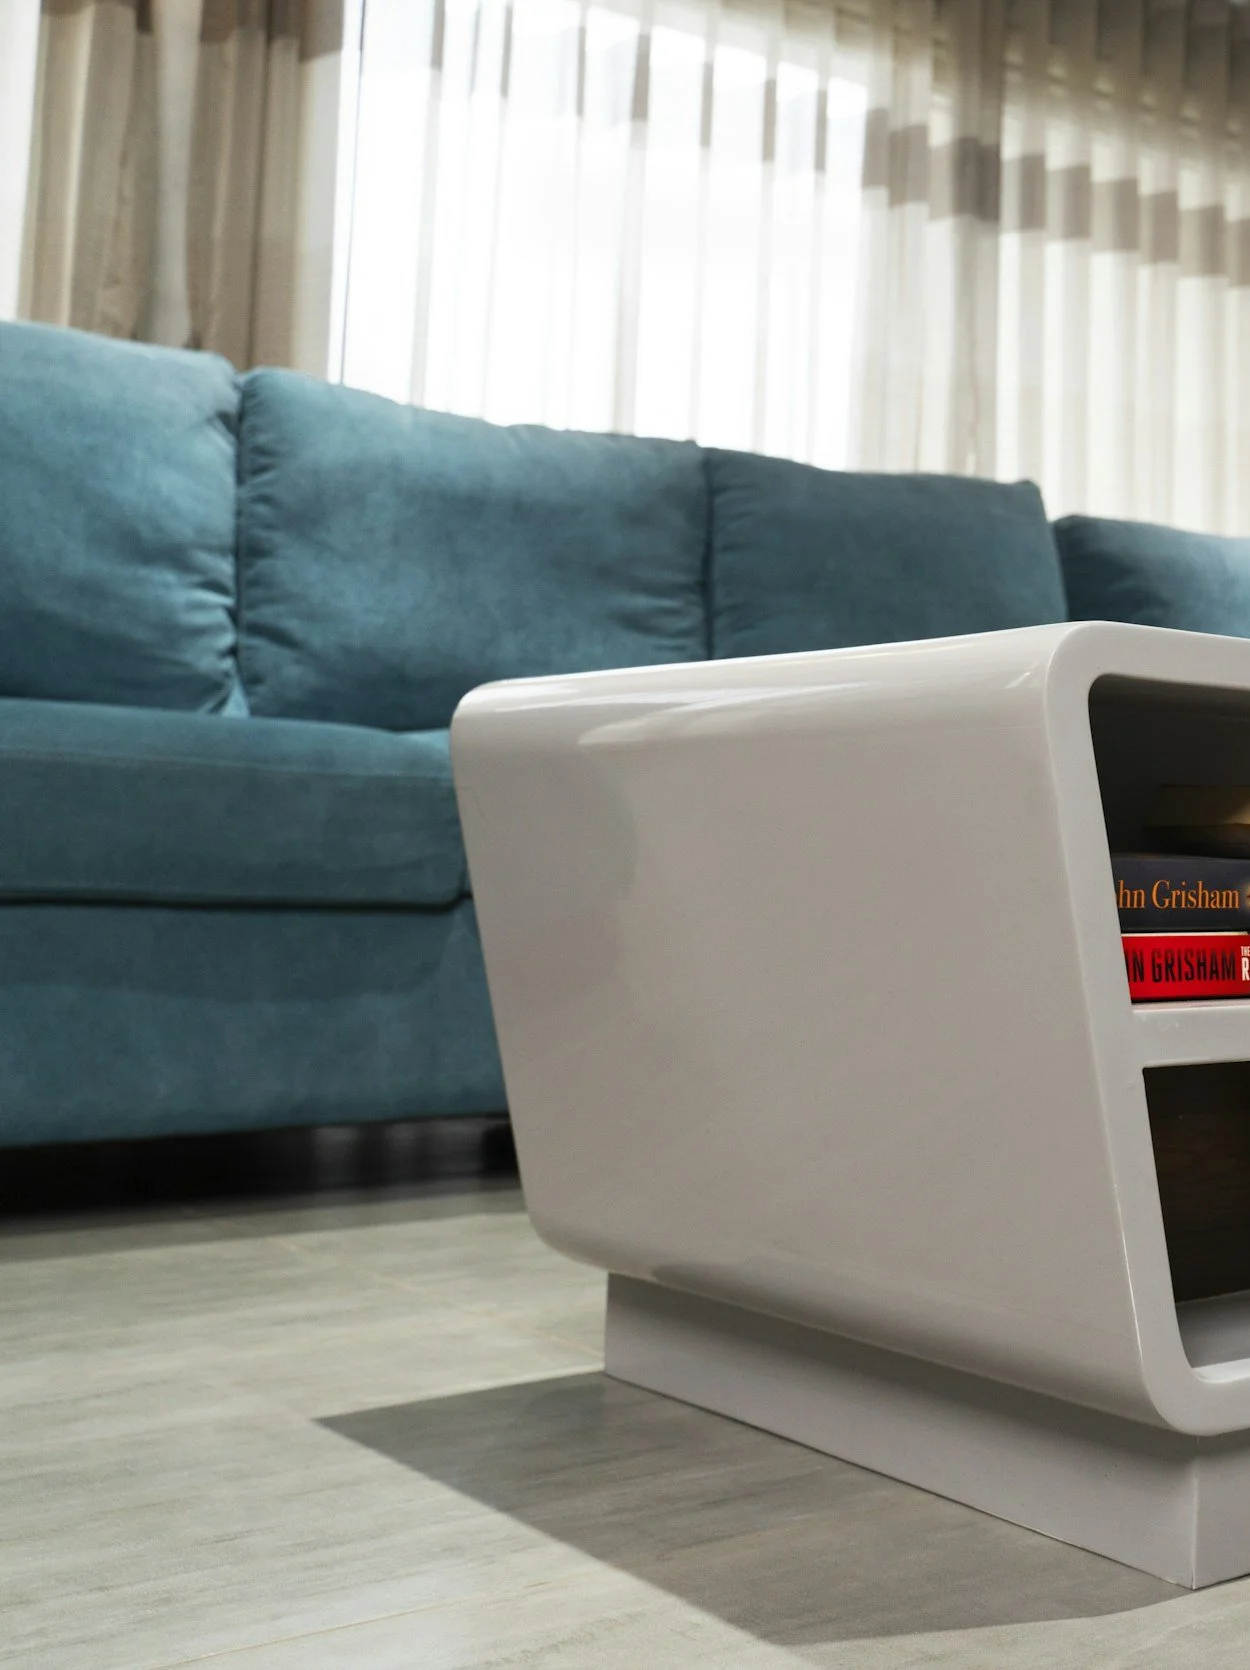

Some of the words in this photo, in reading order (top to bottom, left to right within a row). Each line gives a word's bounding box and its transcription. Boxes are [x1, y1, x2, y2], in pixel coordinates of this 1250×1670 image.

[1116, 879, 1146, 909] hn
[1151, 879, 1240, 909] Grisham
[1151, 946, 1236, 984] GRISHAM
[1240, 945, 1250, 957] THE
